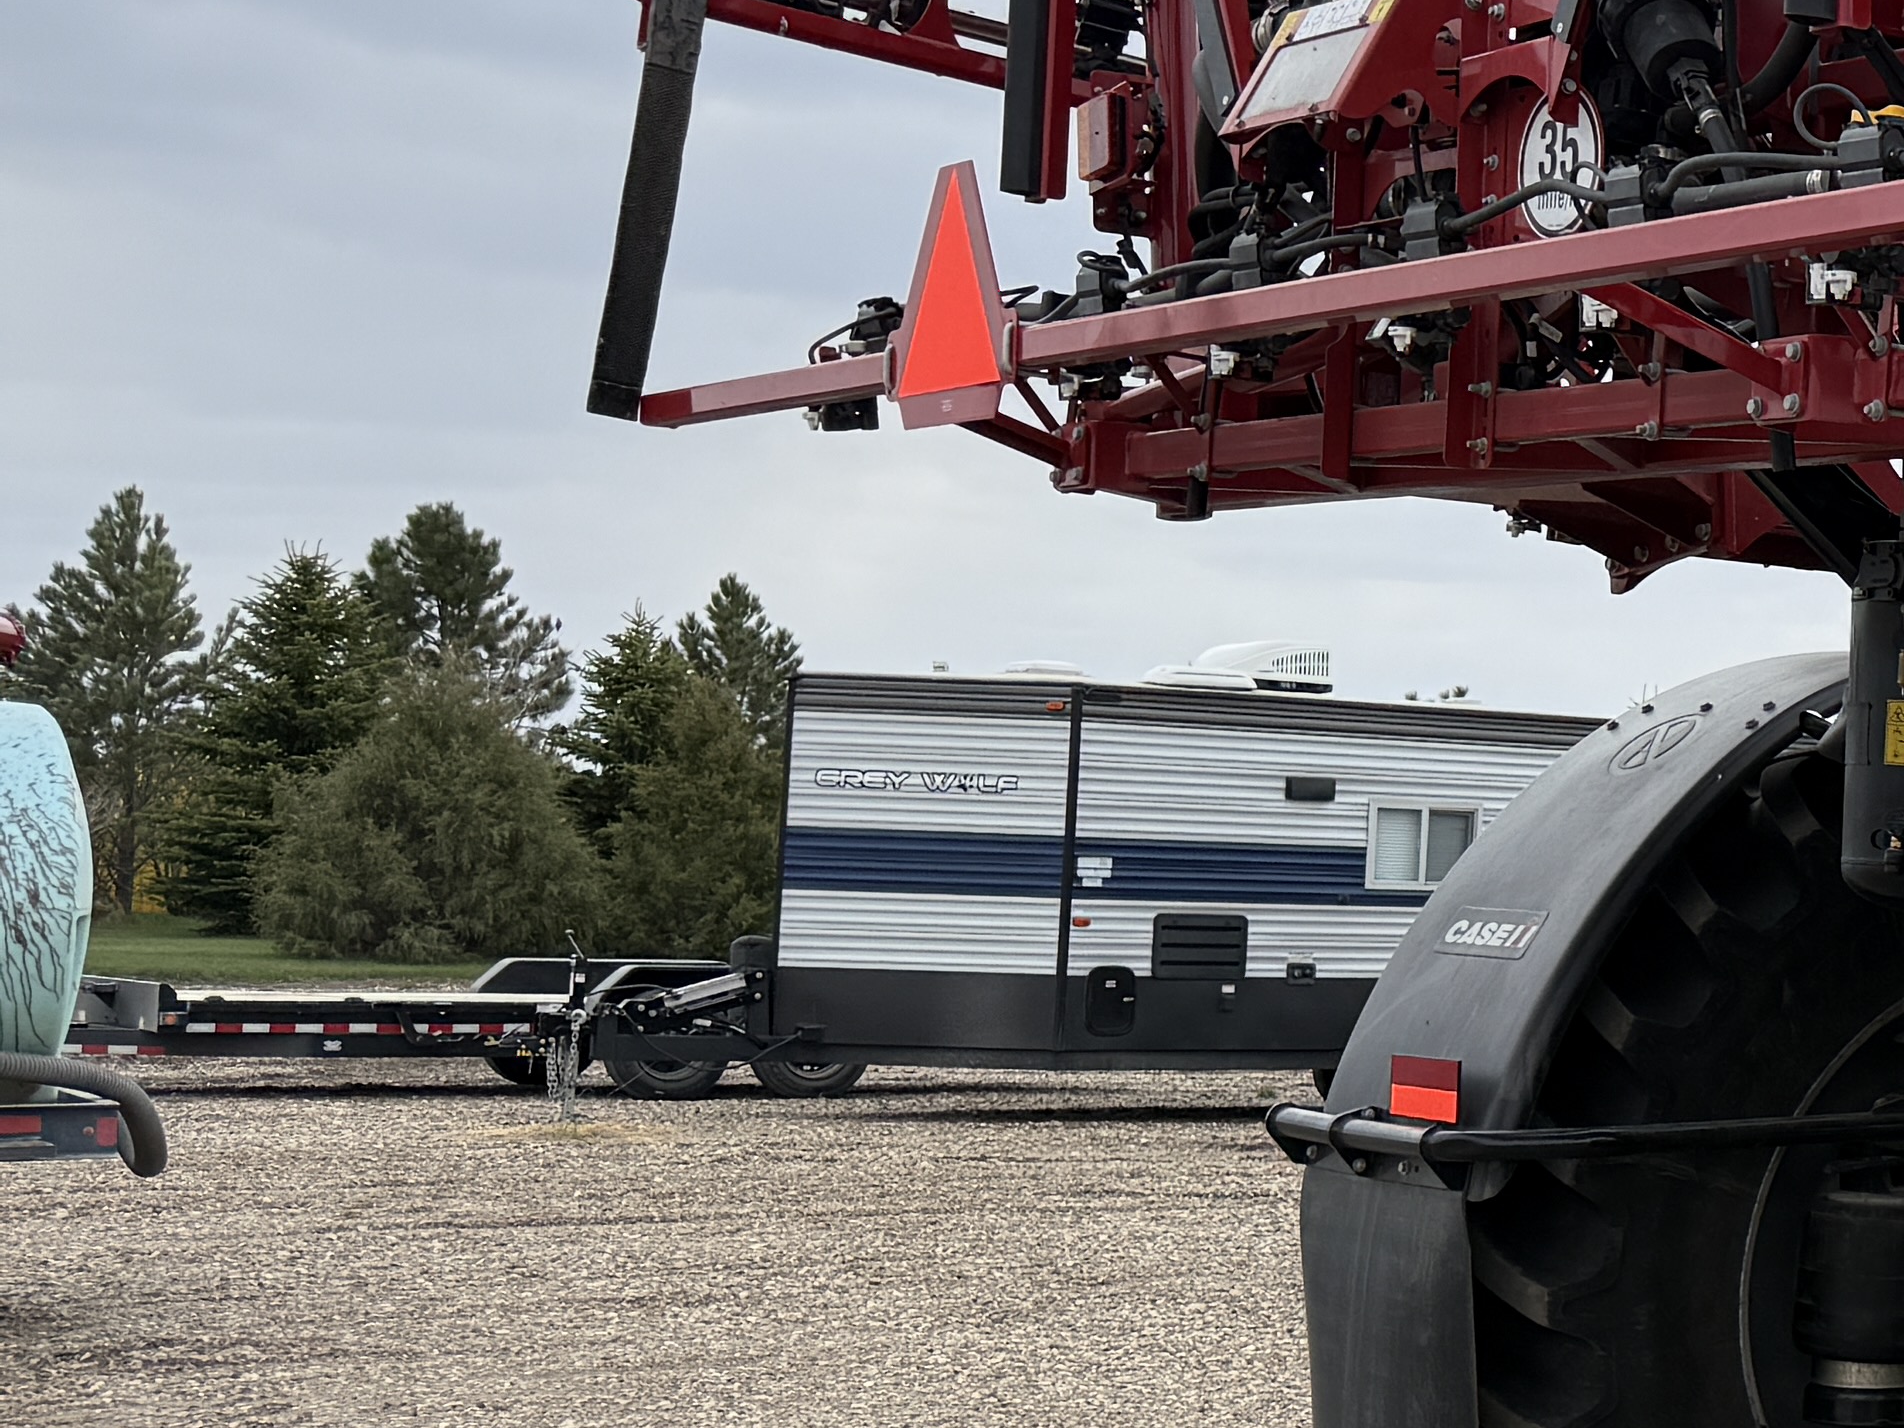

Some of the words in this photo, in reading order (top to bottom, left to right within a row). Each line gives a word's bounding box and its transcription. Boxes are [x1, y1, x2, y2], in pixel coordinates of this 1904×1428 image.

[1538, 120, 1579, 183] 35
[815, 768, 911, 791] GREY
[1445, 919, 1513, 947] CASE
